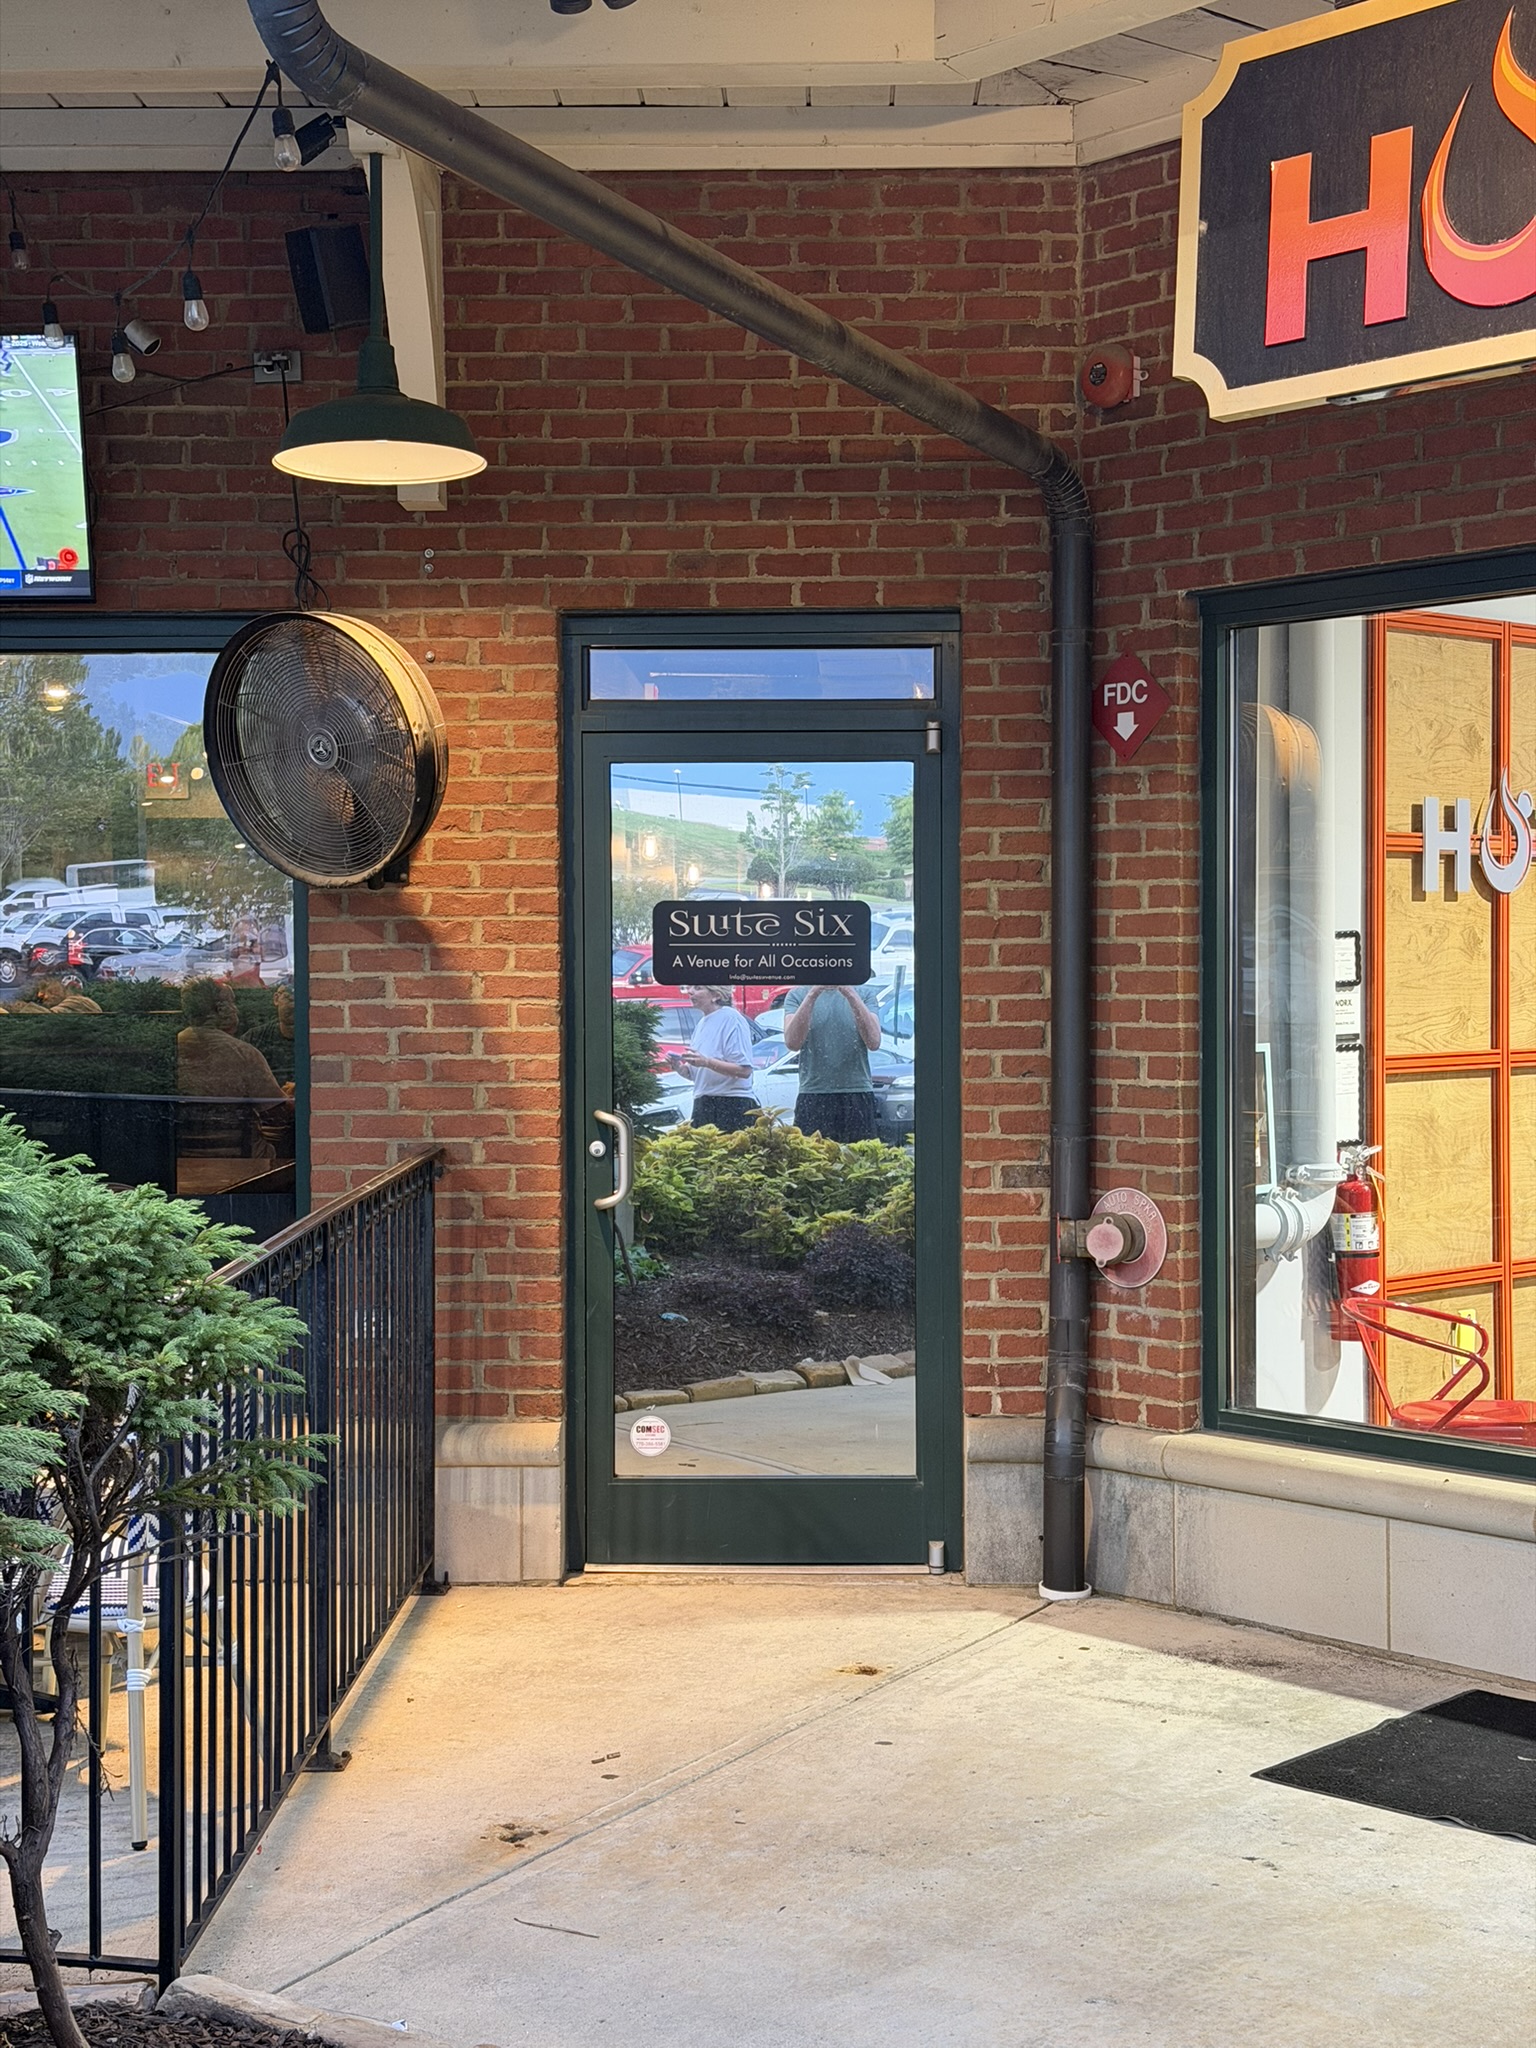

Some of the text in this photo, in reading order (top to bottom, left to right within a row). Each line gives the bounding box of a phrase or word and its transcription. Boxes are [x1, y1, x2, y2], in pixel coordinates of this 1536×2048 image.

[1103, 679, 1148, 707] FDC
[669, 906, 854, 937] Suite Six
[672, 953, 853, 968] A Venue for All Occasions
[1103, 1191, 1157, 1221] AUTO SPKR
[636, 1425, 665, 1433] COMSEC
